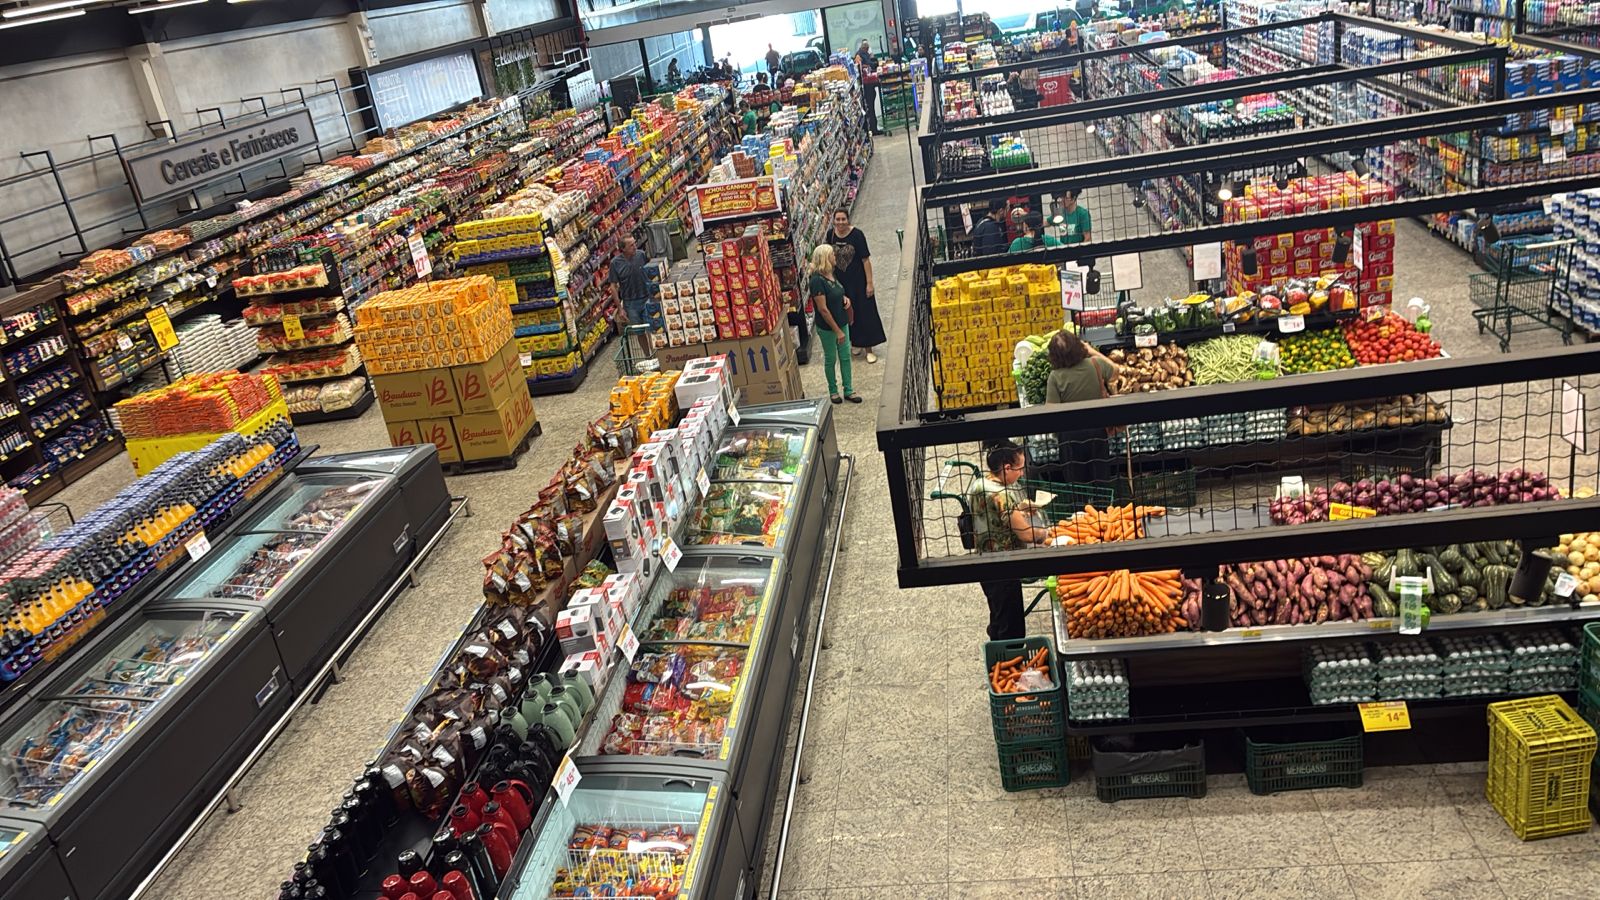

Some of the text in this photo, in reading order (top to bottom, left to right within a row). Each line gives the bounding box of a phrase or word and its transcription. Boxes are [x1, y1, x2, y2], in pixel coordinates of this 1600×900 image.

[161, 126, 299, 184] Cereais e Farináceos
[1304, 232, 1322, 243] Conti
[1254, 239, 1272, 250] Conti
[1294, 246, 1312, 257] Conti
[1368, 250, 1387, 262] Conti
[1270, 265, 1288, 276] Conti
[1368, 293, 1386, 304] Conti
[379, 388, 423, 404] Bauducco
[460, 426, 504, 442] Bauducco
[1016, 761, 1054, 774] MENEGASSI
[1286, 764, 1327, 775] MENEGASSI
[1130, 773, 1171, 784] MENEGASSI
